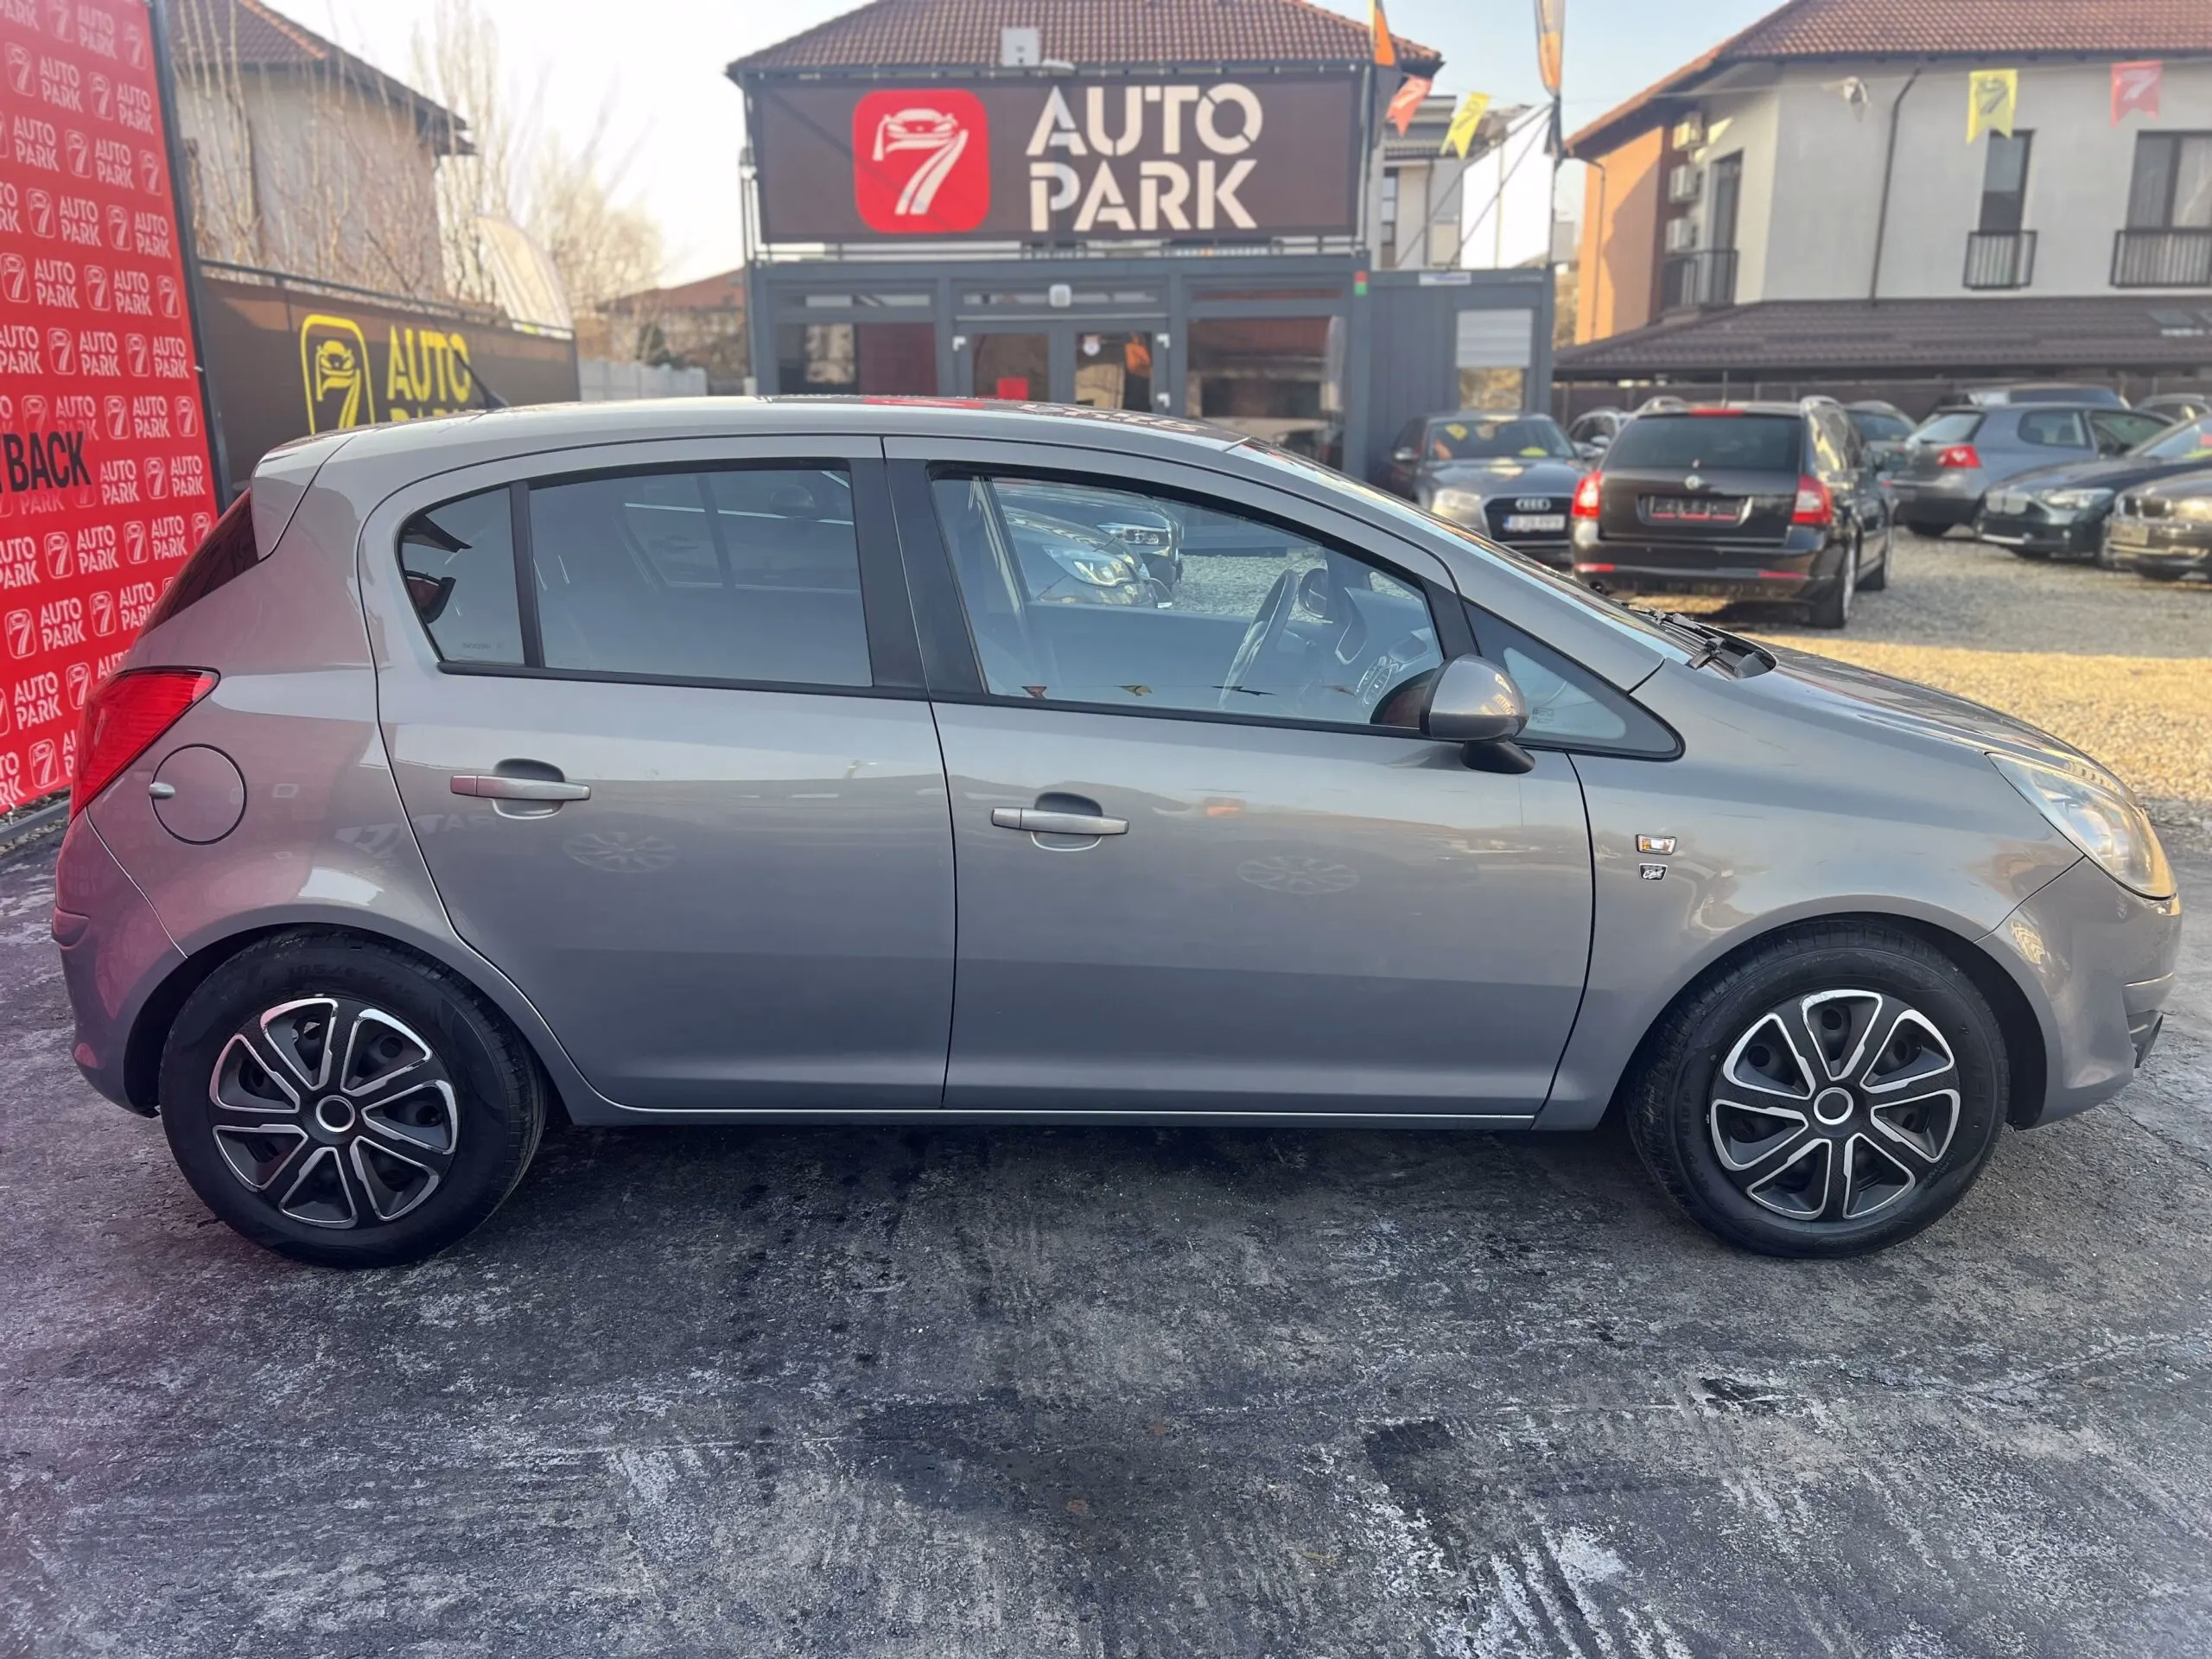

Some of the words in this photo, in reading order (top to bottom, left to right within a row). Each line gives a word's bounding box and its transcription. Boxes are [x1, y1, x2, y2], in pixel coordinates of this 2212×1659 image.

[0, 0, 40, 31] ARK
[77, 4, 114, 36] AUTO
[79, 26, 118, 60] PARK
[40, 56, 79, 88] AUTO
[41, 79, 83, 112] PARK
[117, 84, 151, 112] AUTO
[14, 115, 56, 146] AUTO
[118, 103, 154, 135] PARK
[1026, 83, 1263, 156] AUTO
[15, 138, 60, 172] PARK
[95, 138, 131, 166] AUTO
[97, 162, 134, 190] PARK
[60, 195, 99, 222] AUTO
[1031, 160, 1258, 232] PARK
[0, 208, 22, 234] RK
[61, 219, 102, 247] PARK
[135, 213, 168, 237] AUTO
[137, 233, 171, 259] PARK
[35, 258, 75, 283] AUTO
[114, 270, 149, 293] AUTO
[35, 283, 79, 309] PARK
[115, 292, 152, 316] PARK
[79, 331, 118, 354] AUTO
[153, 336, 186, 358] AUTO
[81, 353, 121, 377] PARK
[154, 358, 190, 378] PARK
[387, 324, 472, 403] AUTO
[56, 396, 96, 418] AUTO
[133, 396, 168, 417] AUTO
[134, 418, 170, 439] PARK
[3, 430, 92, 493] BACK
[100, 460, 137, 482] AUTO
[170, 455, 203, 477] AUTO
[101, 481, 140, 505] PARK
[172, 476, 206, 498] PARK
[19, 489, 65, 516] PARK
[76, 525, 116, 551] AUTO
[151, 516, 184, 539] AUTO
[0, 536, 36, 564] UTO
[78, 547, 119, 575] PARK
[152, 537, 188, 561] PARK
[119, 582, 155, 608] AUTO
[40, 597, 82, 628] AUTO
[41, 620, 86, 652] PARK
[97, 650, 130, 679] AUT
[14, 671, 58, 706] AUTO
[16, 697, 62, 730] PARK
[0, 751, 20, 775] TO
[0, 775, 26, 806] RK
